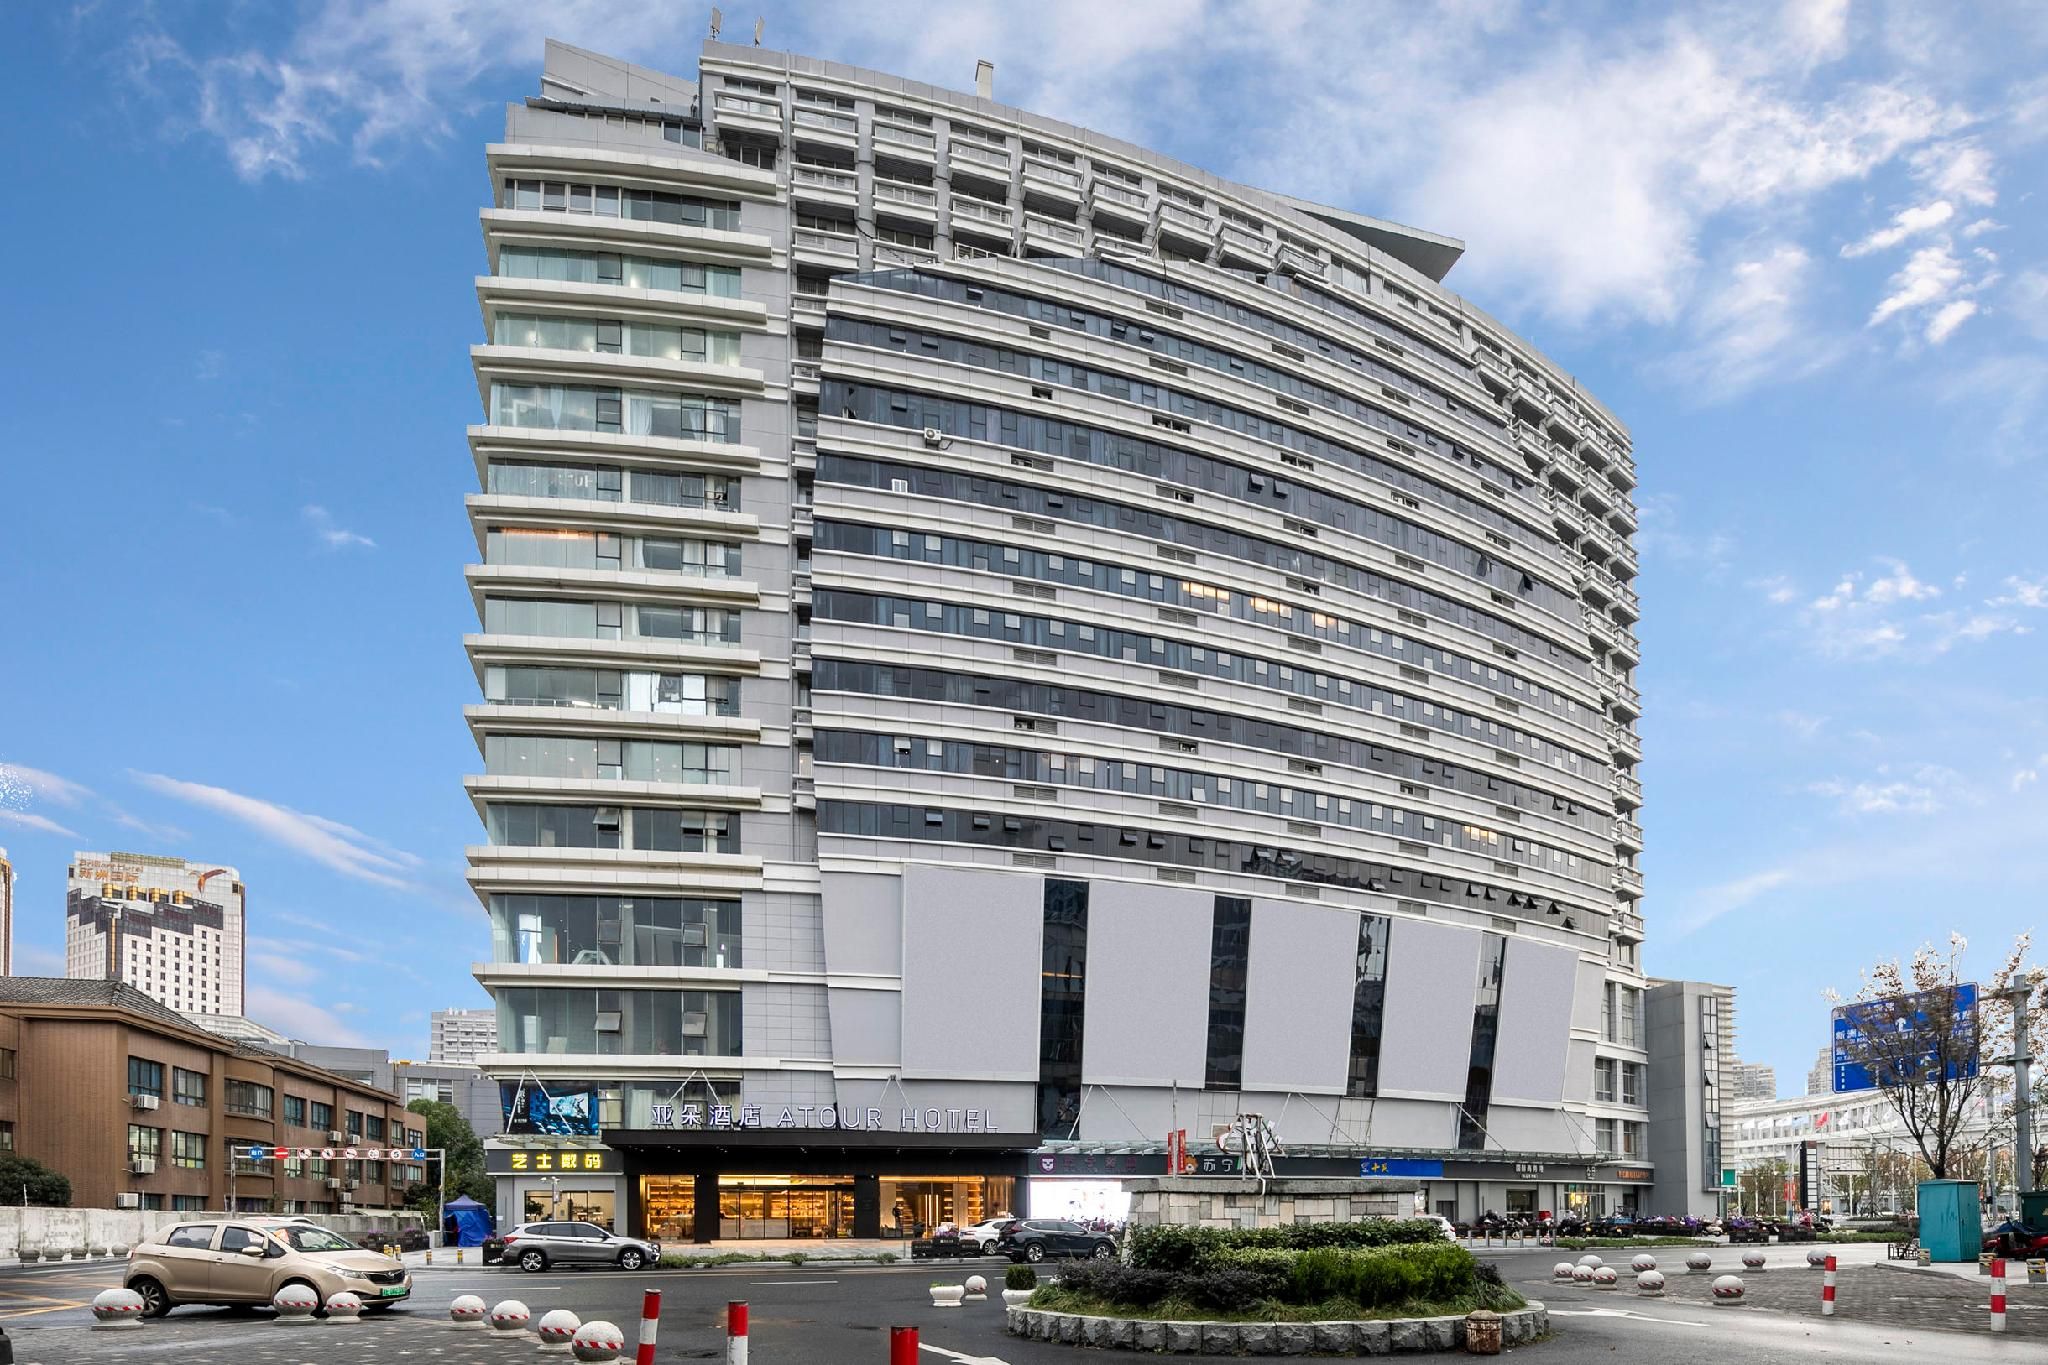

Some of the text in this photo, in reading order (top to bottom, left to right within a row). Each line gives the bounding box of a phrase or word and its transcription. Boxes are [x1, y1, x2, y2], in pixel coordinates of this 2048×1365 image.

[651, 1104, 761, 1127] 亚朵酒店
[777, 1106, 998, 1130] ATOUR HOTEL
[511, 1153, 601, 1169] 芝士数码
[1203, 1158, 1234, 1172] 苏宁
